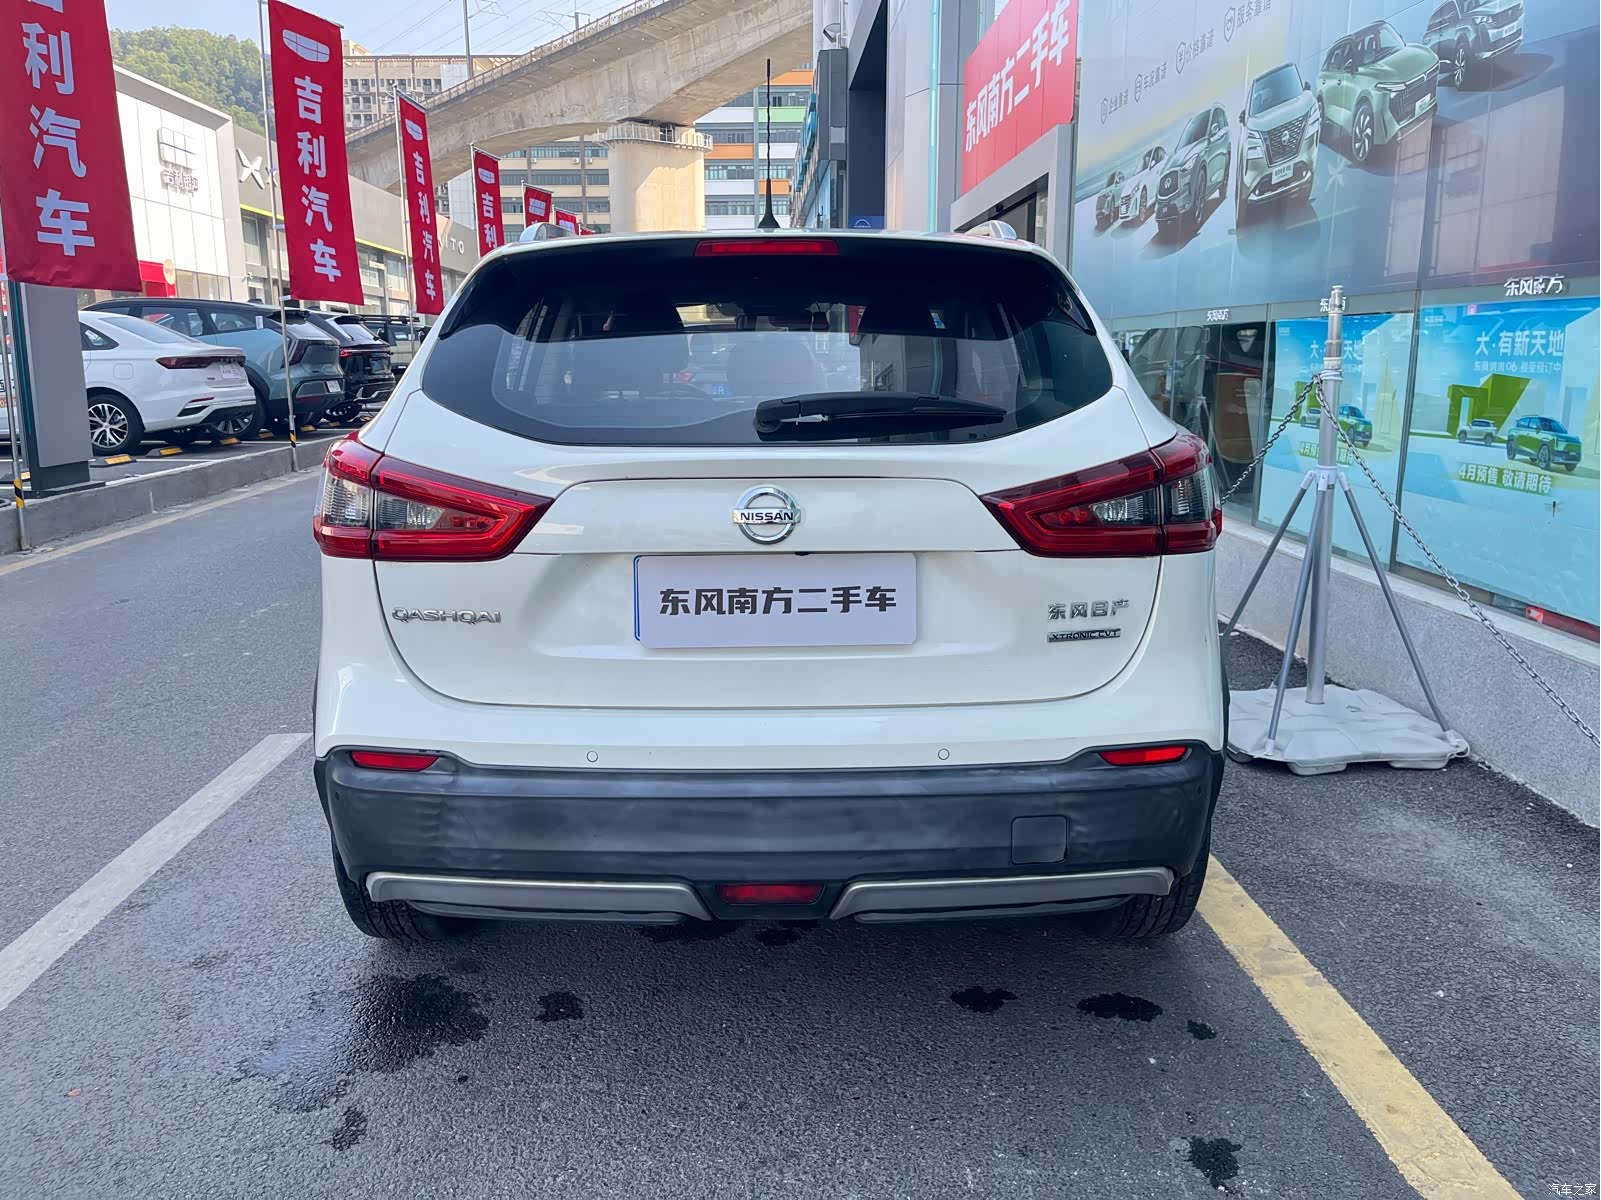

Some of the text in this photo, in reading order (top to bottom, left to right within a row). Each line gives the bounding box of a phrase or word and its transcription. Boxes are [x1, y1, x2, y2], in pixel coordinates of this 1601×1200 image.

[965, 0, 1070, 153] 东风南方二手车
[21, 0, 95, 257] 利汽车
[293, 75, 342, 283] 吉利汽车
[412, 151, 437, 300] 吉利汽车
[1458, 464, 1552, 494] 4月预售 敬请期待
[740, 512, 794, 521] NISSAN
[391, 606, 502, 625] QASHQAI
[659, 585, 897, 616] 东风南方二手车
[1047, 598, 1130, 620] 东风日产
